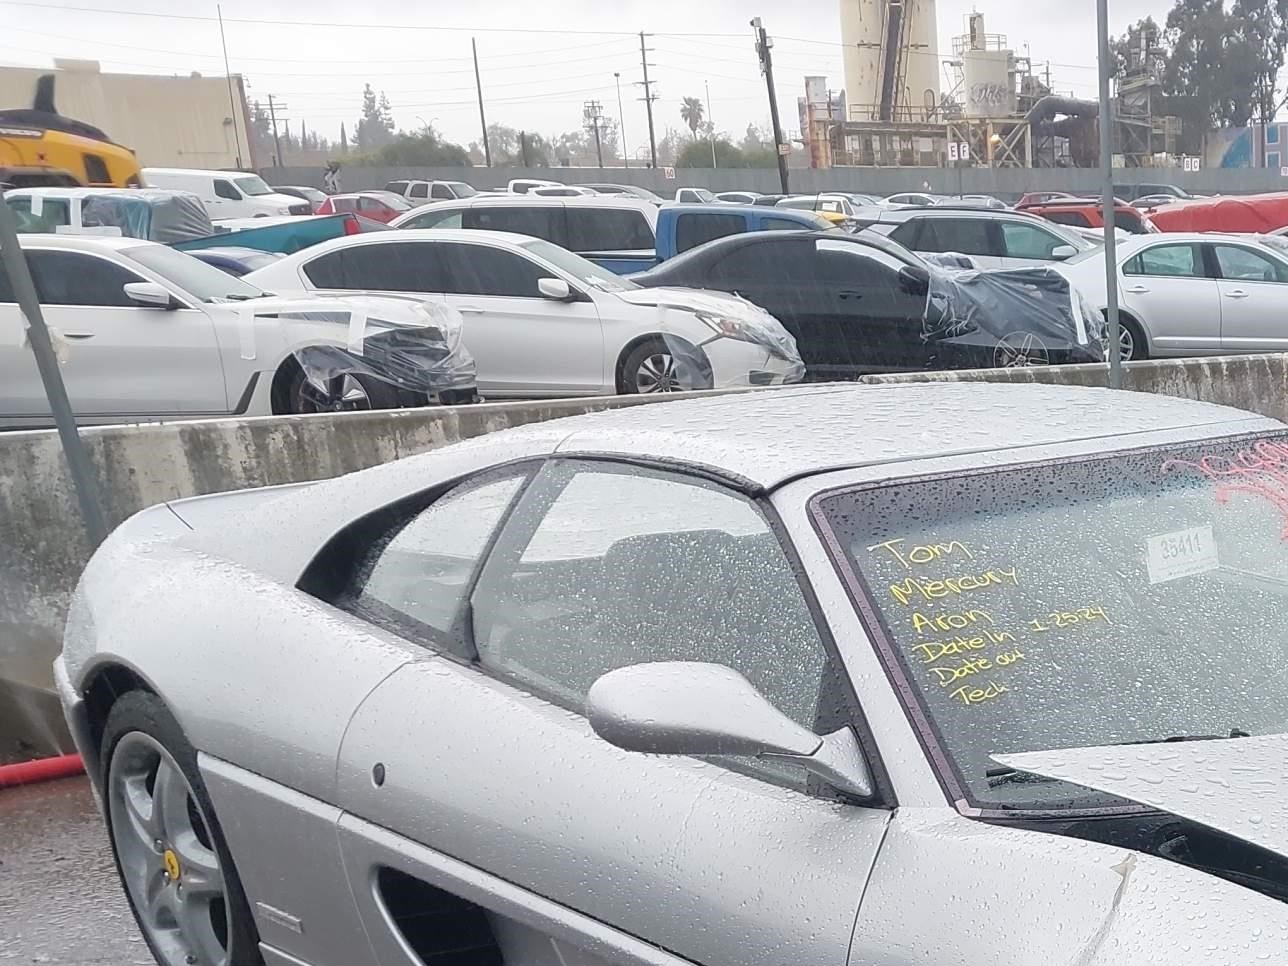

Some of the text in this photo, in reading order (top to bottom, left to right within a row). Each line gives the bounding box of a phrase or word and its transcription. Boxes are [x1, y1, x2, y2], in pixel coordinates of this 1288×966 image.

[867, 538, 974, 569] Tom
[889, 566, 1019, 605] Mercury
[911, 608, 994, 634] Aron
[927, 649, 1026, 687] Date out
